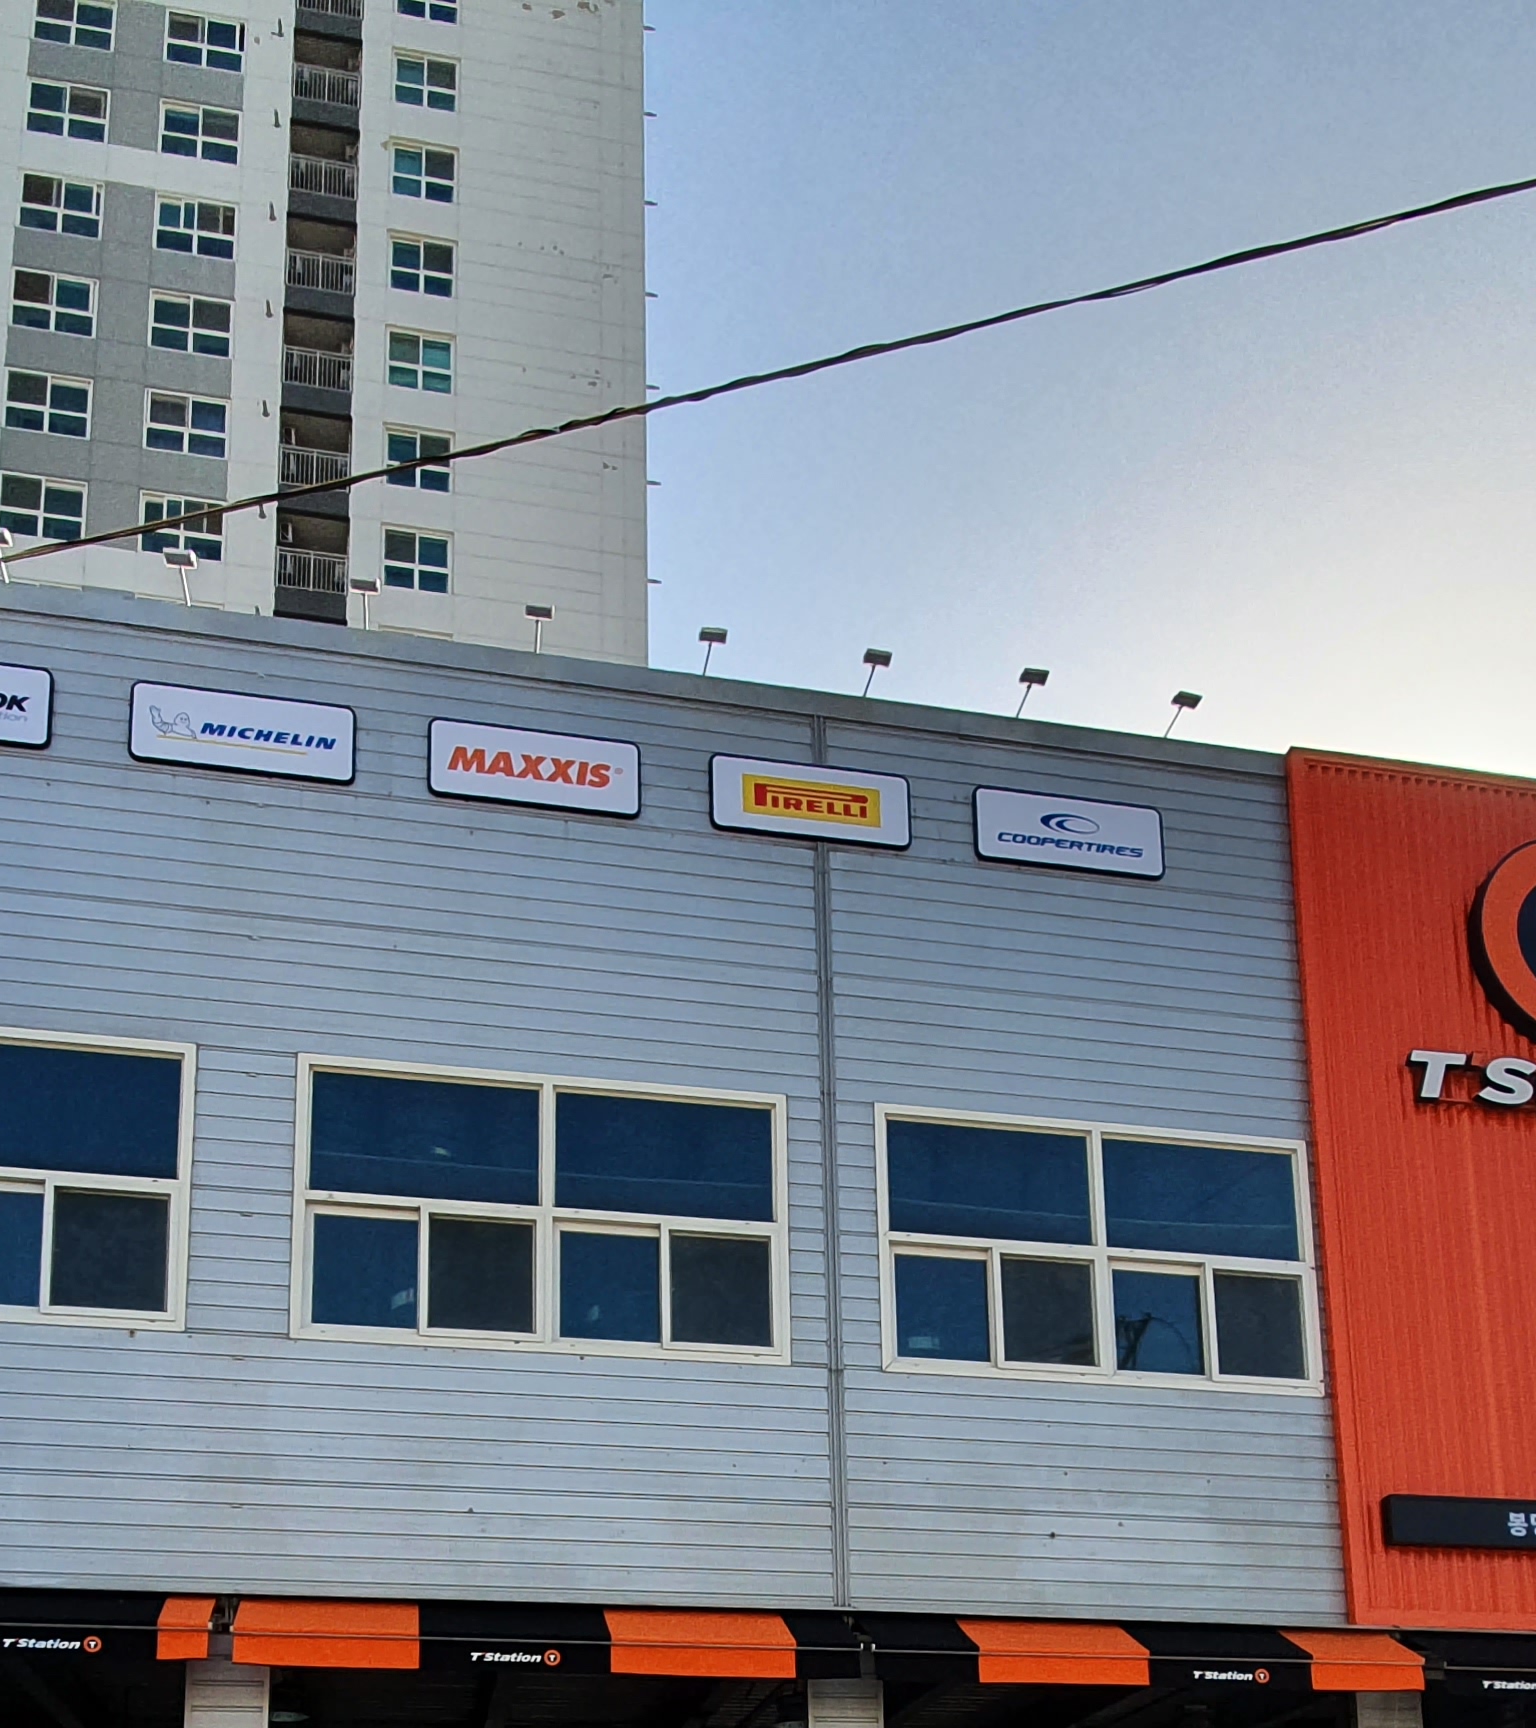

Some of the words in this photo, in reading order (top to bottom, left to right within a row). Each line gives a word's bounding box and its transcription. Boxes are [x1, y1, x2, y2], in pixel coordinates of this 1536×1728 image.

[200, 722, 337, 750] MICHELIN
[448, 746, 612, 789] MAXXIS
[754, 782, 868, 819] PIRELLI
[1410, 1049, 1467, 1099] T
[16, 1638, 81, 1650] Station
[483, 1652, 542, 1665] Station
[1204, 1671, 1254, 1682] Station
